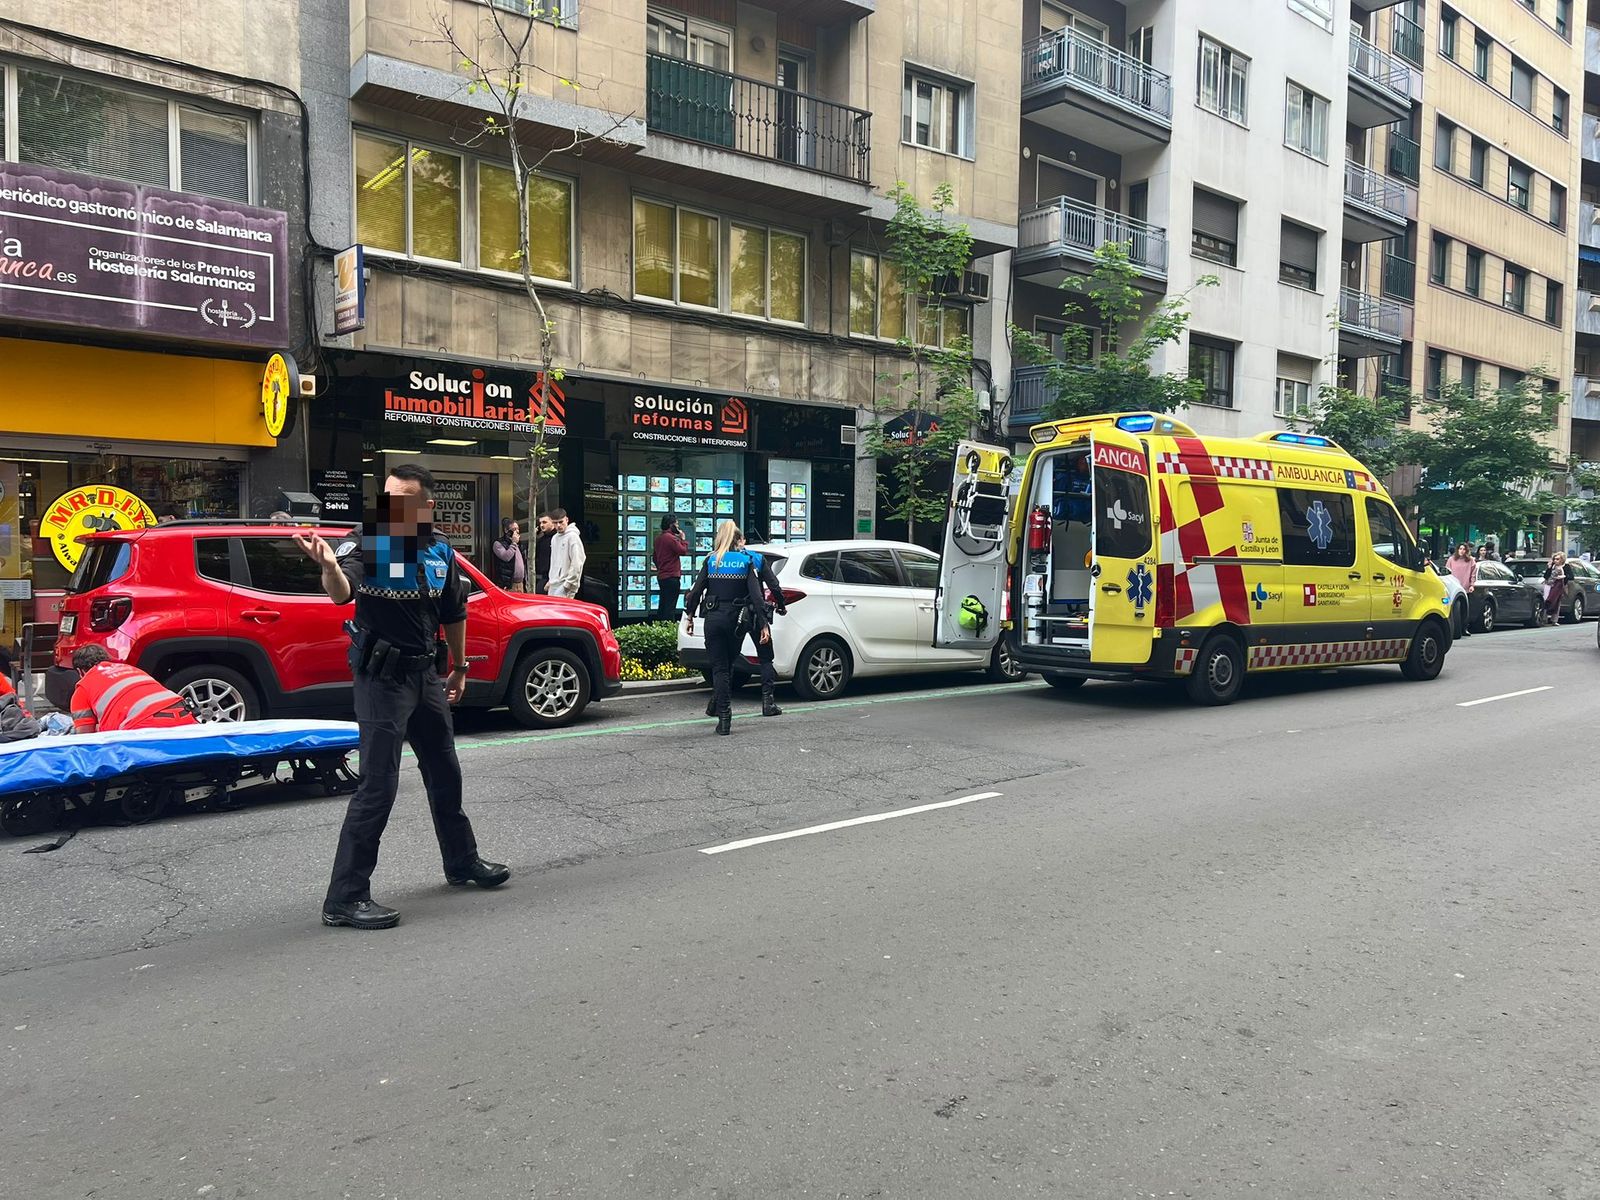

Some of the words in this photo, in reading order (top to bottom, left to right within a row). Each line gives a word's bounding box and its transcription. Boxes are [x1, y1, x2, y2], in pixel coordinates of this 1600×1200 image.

[0, 188, 67, 209] eriódico
[69, 200, 173, 226] gastronómico
[175, 215, 194, 230] de
[196, 219, 272, 243] Salamanca
[88, 247, 165, 266] Organizadores
[167, 259, 180, 268] de
[182, 260, 196, 271] los
[198, 261, 256, 280] Premios
[89, 258, 167, 280] Hostelería
[170, 269, 255, 293] Salamanca
[634, 395, 713, 415] solución
[384, 412, 432, 424] REFORMAS
[435, 417, 511, 431] CONSTRUCCIONES
[513, 424, 567, 436] INTERRISMO
[633, 412, 713, 431] reformas
[632, 431, 697, 444] CONSTRUCCIONES
[701, 437, 748, 448] INTERIORISMO
[1094, 447, 1142, 471] ANCIA
[1277, 465, 1345, 484] AMBULANCIA
[433, 481, 468, 491] ZACIÓN
[433, 491, 463, 500] NTANA
[48, 493, 90, 529] MR
[432, 501, 471, 511] SIVOS
[433, 511, 471, 523] LETS
[1128, 510, 1144, 524] Sacyl
[1240, 545, 1260, 553] Castilla
[1255, 536, 1270, 544] Junta
[1271, 536, 1278, 544] de
[59, 543, 78, 567] Alwa
[1393, 574, 1405, 588] 112
[1268, 592, 1283, 601] Sacyl
